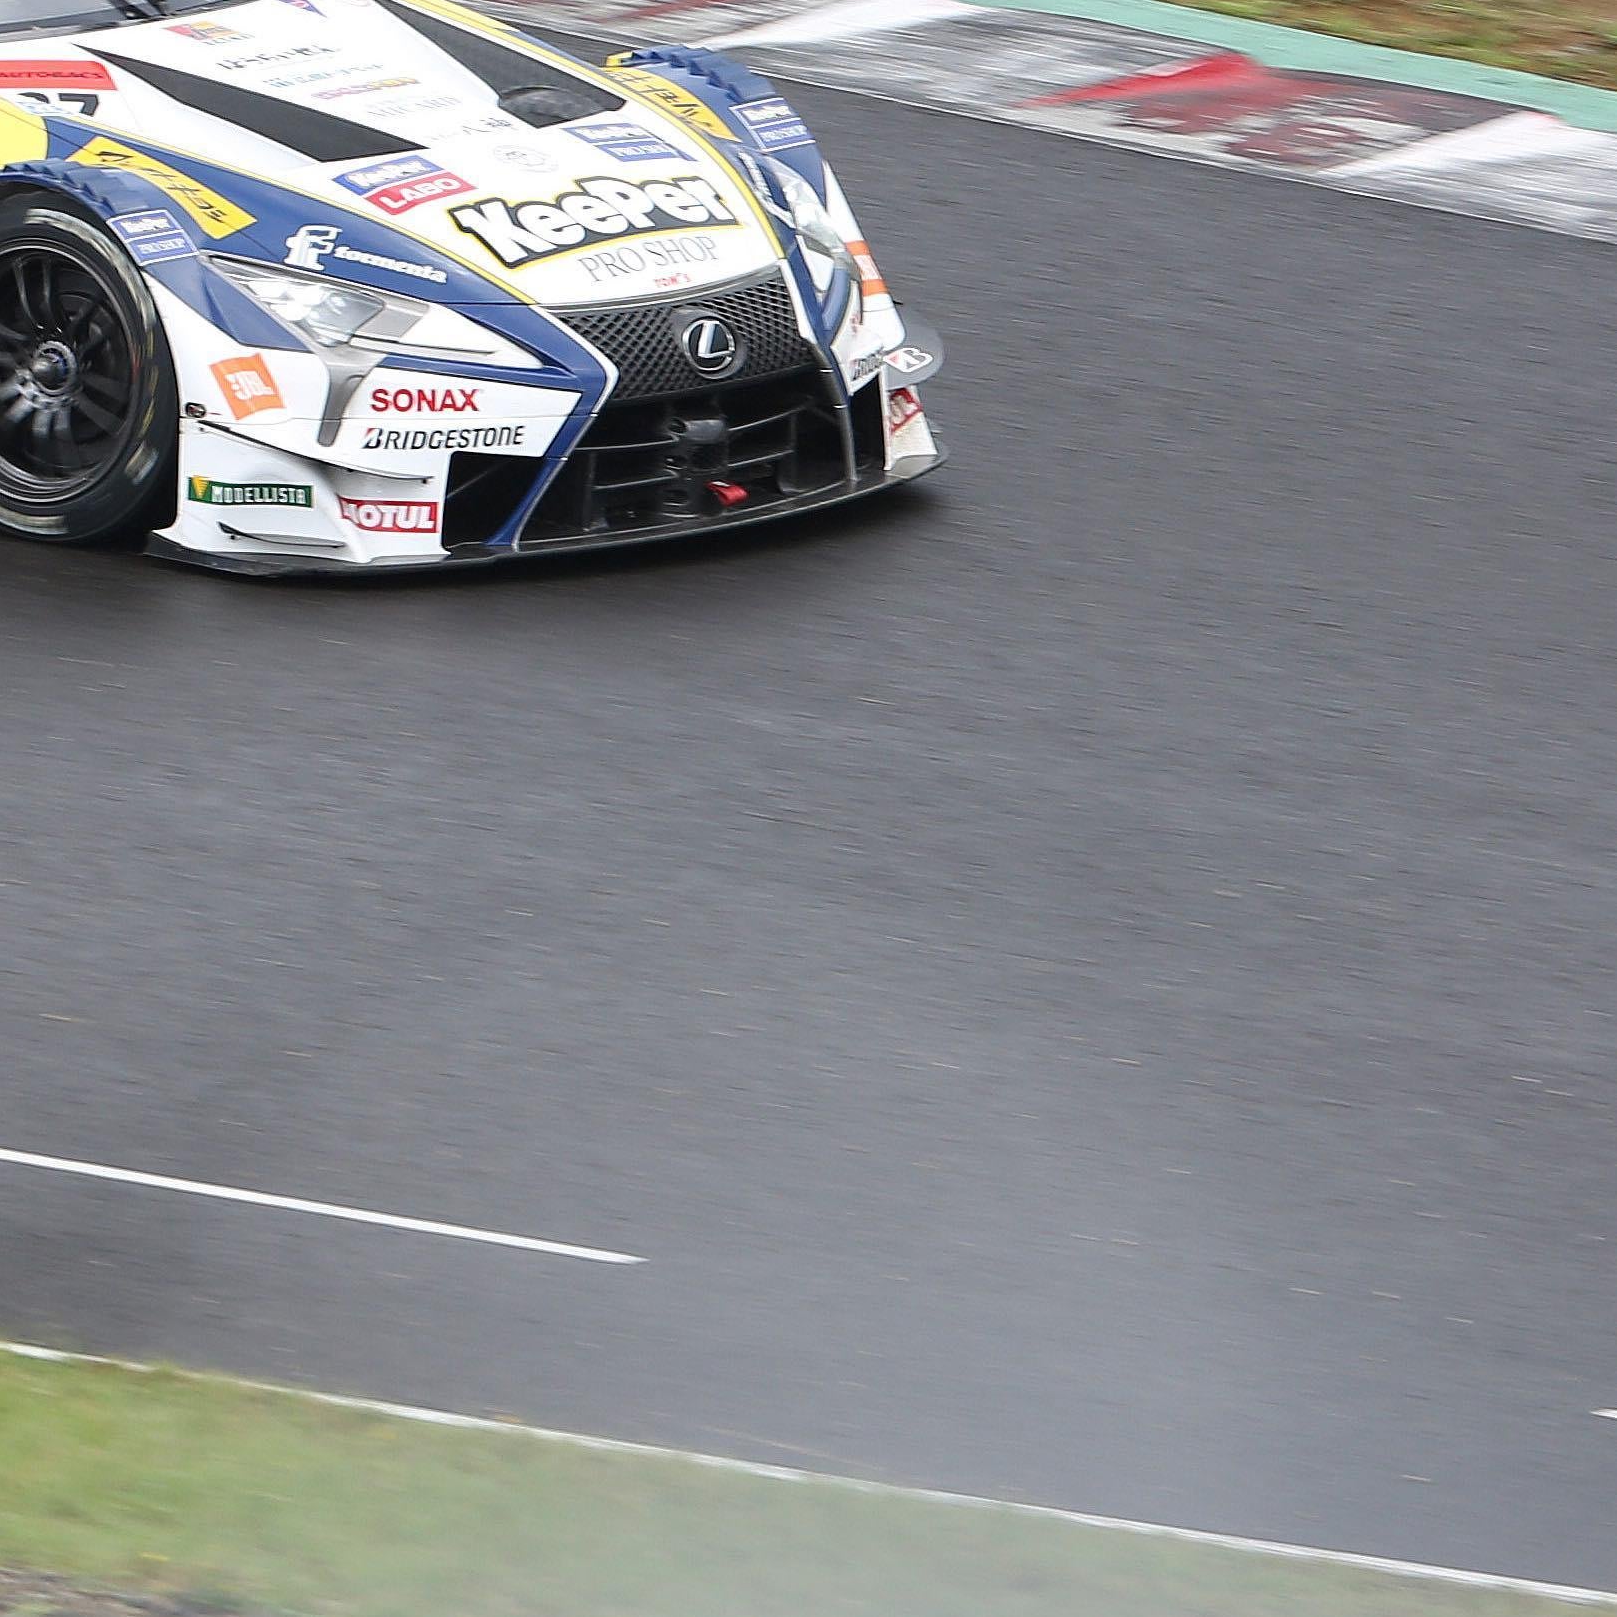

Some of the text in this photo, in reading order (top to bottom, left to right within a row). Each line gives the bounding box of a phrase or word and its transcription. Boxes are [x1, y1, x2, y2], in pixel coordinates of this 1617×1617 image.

[378, 176, 463, 210] LABO
[448, 175, 740, 270] KeePer
[578, 235, 720, 282] PRO SHOP
[370, 388, 480, 412] SONAX
[362, 425, 526, 450] BRIDGESTONE
[211, 484, 307, 505] MODELLISTA
[341, 501, 435, 530] MOTUL
